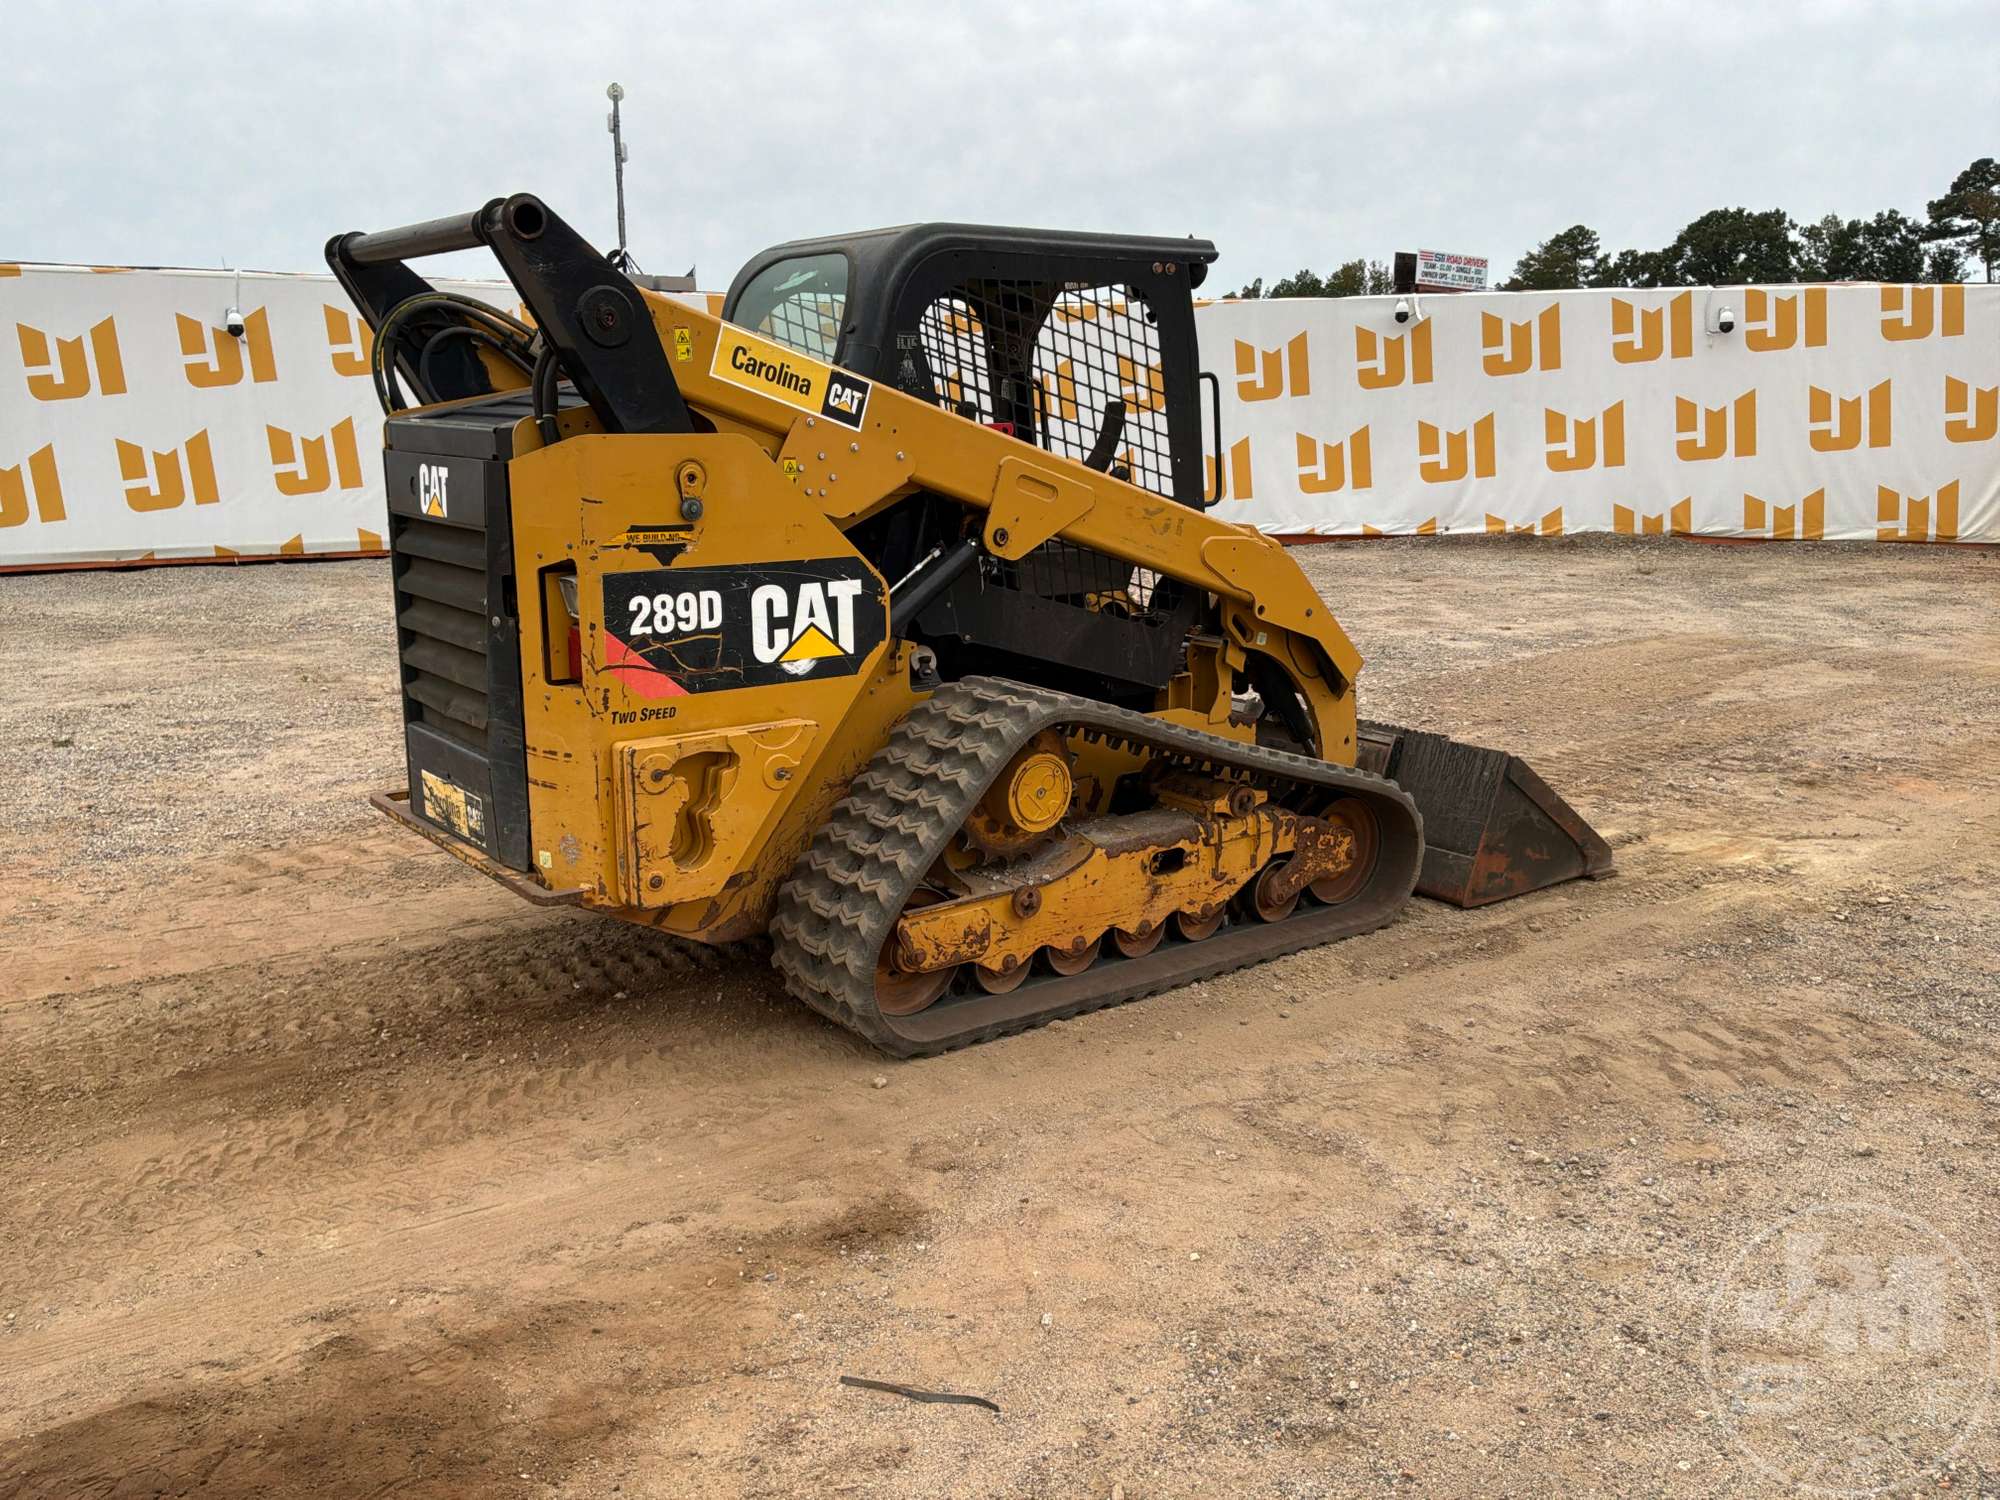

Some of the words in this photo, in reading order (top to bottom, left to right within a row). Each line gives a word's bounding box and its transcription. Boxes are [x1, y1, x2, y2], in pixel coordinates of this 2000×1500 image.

[1424, 262, 1436, 270] TEAM
[1455, 265, 1471, 274] SINGLE
[1446, 255, 1462, 265] ROAD
[1463, 256, 1488, 268] DRIVERS
[731, 345, 812, 396] Carolina
[828, 383, 863, 414] CAT
[419, 463, 448, 519] CAT
[629, 590, 722, 636] 289D
[751, 579, 862, 663] CAT
